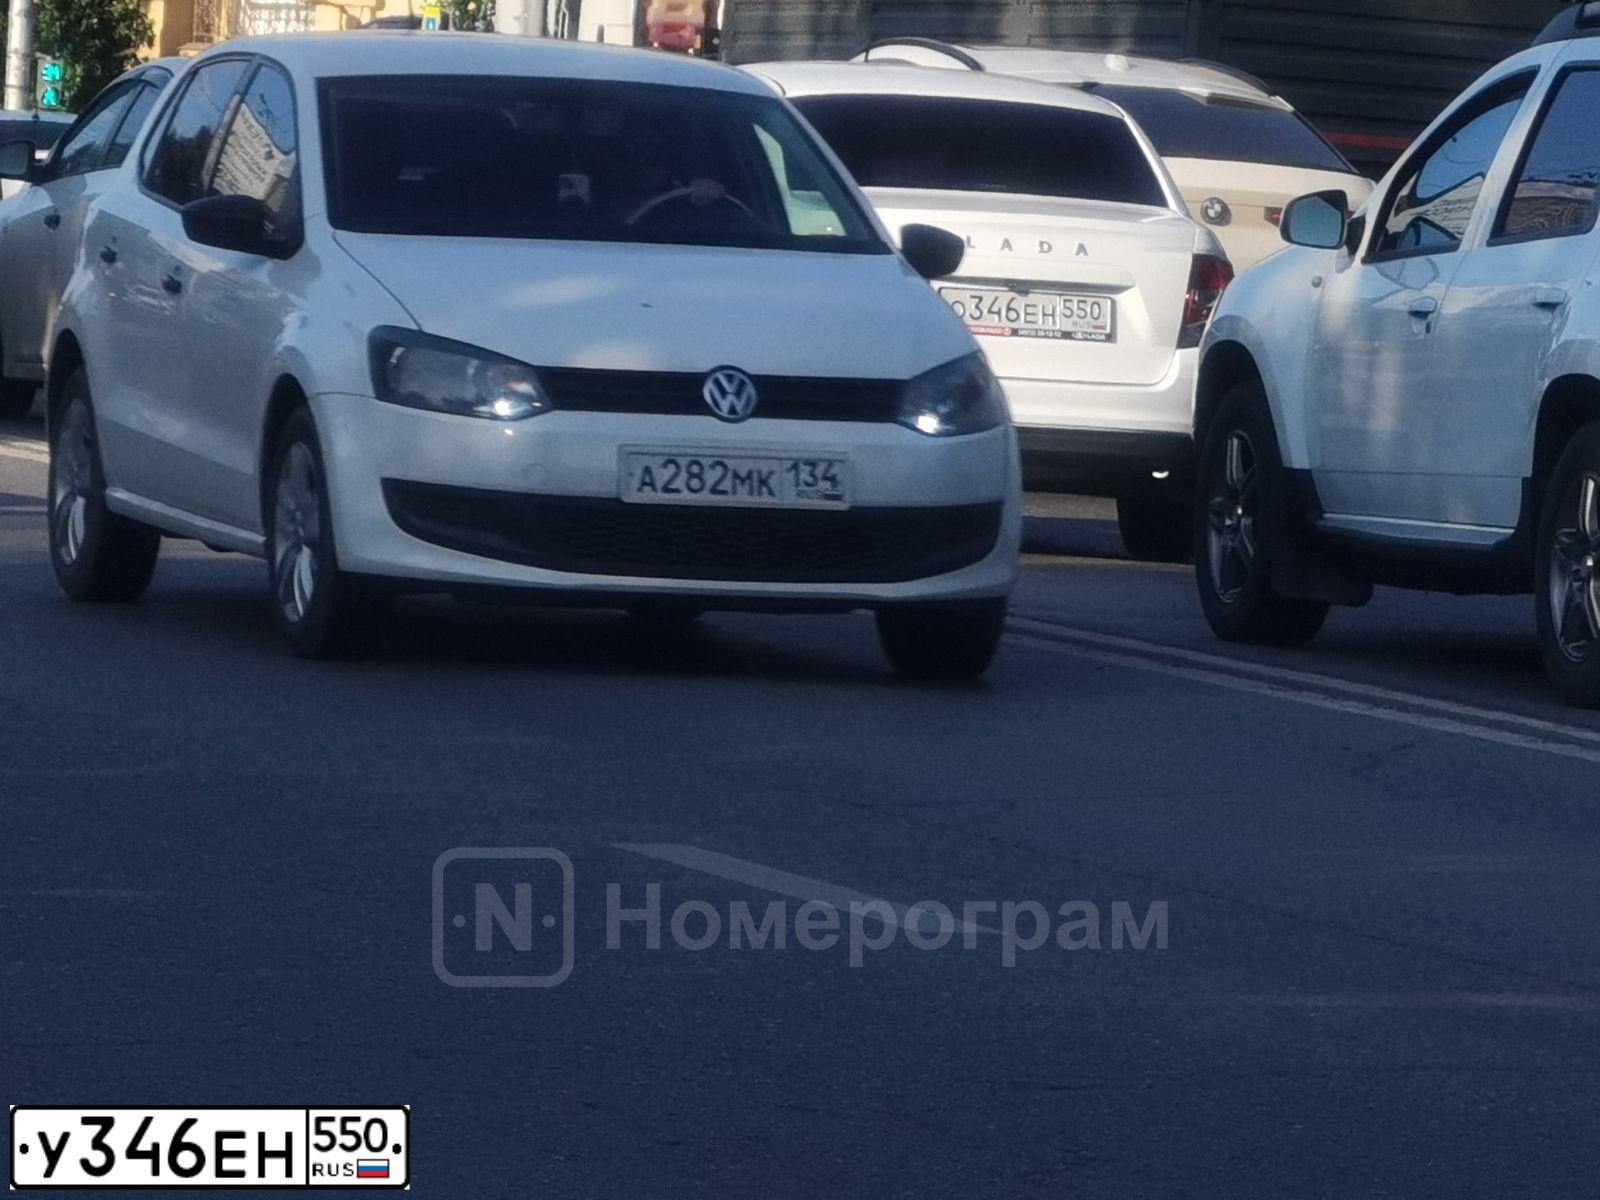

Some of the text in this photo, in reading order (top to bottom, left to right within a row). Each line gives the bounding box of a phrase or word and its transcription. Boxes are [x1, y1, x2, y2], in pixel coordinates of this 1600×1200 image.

[966, 235, 1089, 257] LADA
[1062, 299, 1101, 320] 550
[636, 457, 840, 498] А282МК 134
